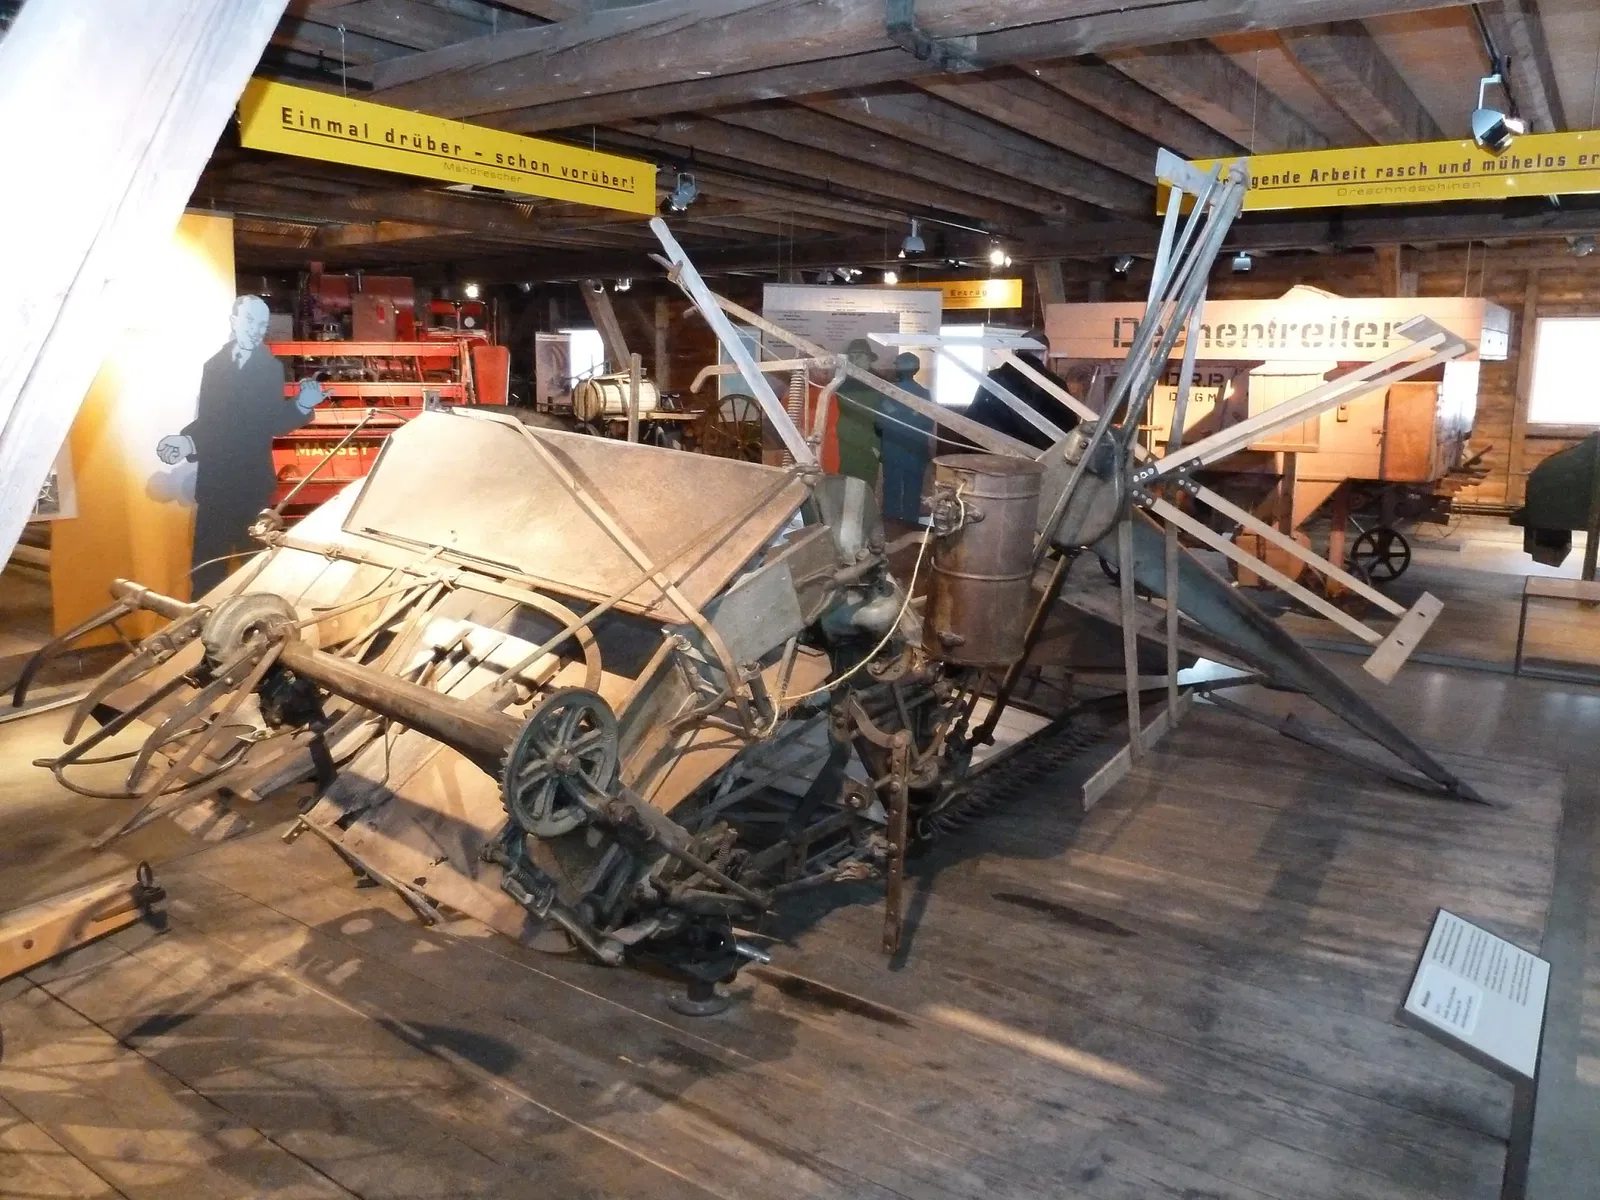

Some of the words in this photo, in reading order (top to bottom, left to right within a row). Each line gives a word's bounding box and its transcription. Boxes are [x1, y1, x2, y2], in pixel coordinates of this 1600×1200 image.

[281, 106, 369, 139] Einmal
[385, 128, 462, 156] drüber
[495, 152, 550, 174] schon
[561, 164, 635, 189] vorüber!
[1310, 166, 1366, 183] Arbeit
[1376, 162, 1428, 178] rasch
[1438, 158, 1472, 174] und
[1482, 153, 1566, 171] mühelos
[1337, 181, 1481, 197] Dreschmaschinen
[296, 441, 370, 457] MASSEY
